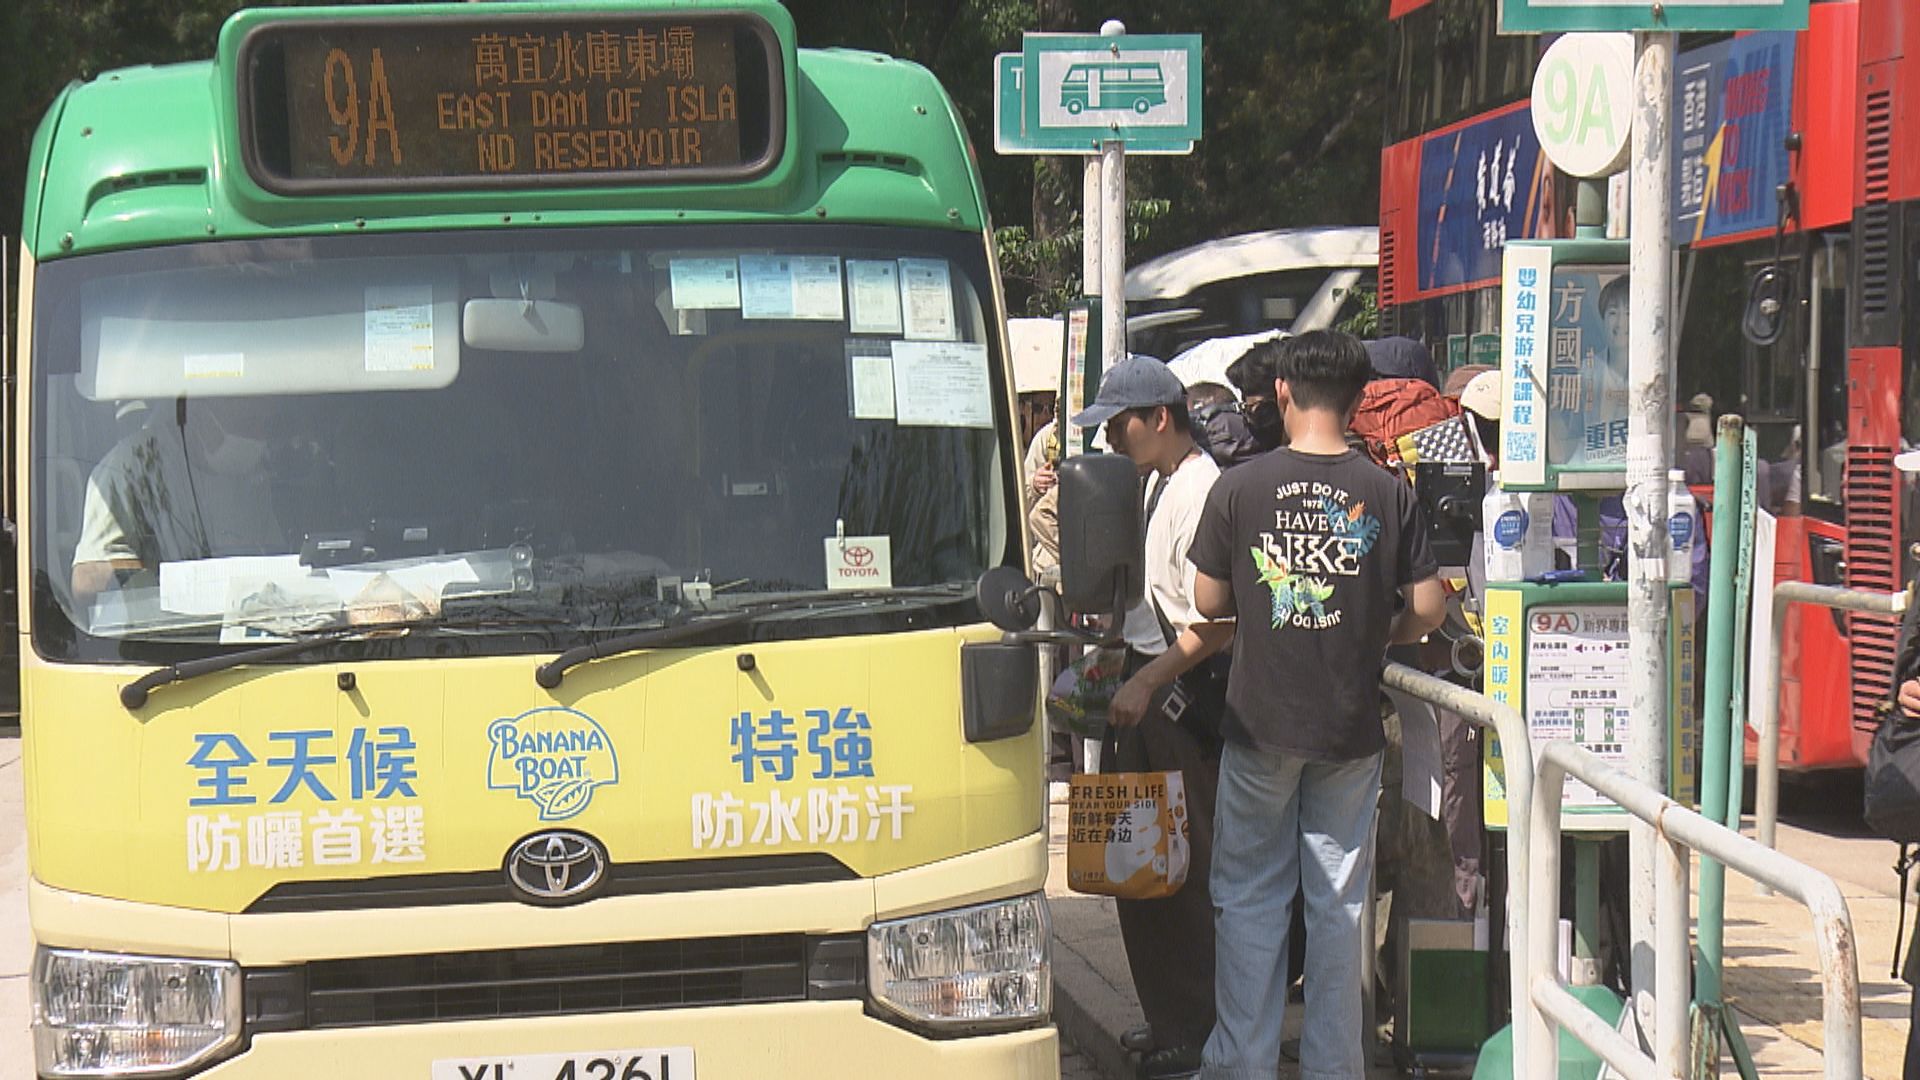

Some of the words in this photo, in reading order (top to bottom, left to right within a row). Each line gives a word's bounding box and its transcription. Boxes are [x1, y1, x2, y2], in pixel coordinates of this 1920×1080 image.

[472, 26, 695, 87] 萬宜水庫東壩
[323, 47, 401, 166] 9A
[437, 91, 511, 130] EAST
[532, 89, 588, 127] DAM
[606, 87, 642, 125] OF
[667, 83, 737, 122] ISLA
[1543, 58, 1617, 147] 9A
[534, 128, 702, 169] RESERVOIR
[1512, 267, 1537, 425] 嬰幼兒游泳課程
[1552, 281, 1586, 413] 方國珊
[1276, 482, 1309, 500] JUST
[1312, 482, 1332, 496] DO
[1275, 510, 1329, 531] HAVE
[1332, 515, 1347, 533] A
[838, 568, 880, 577] TOYOTA
[1259, 532, 1362, 576] NIKE
[1292, 613, 1311, 628] DO
[1536, 613, 1573, 631] 9A
[494, 724, 603, 759] BANANA
[730, 708, 874, 782] 特強
[186, 726, 418, 806] 全天候
[515, 756, 587, 791] BOAT
[1072, 786, 1127, 799] FRESH
[1134, 784, 1164, 798] LIFE
[1072, 801, 1100, 809] NEAR
[1104, 801, 1130, 809] YOUR
[1134, 800, 1157, 809] SIDE
[690, 784, 914, 849] 防水防汗
[1072, 828, 1132, 843] 近在身边
[187, 805, 426, 872] 防曬首選
